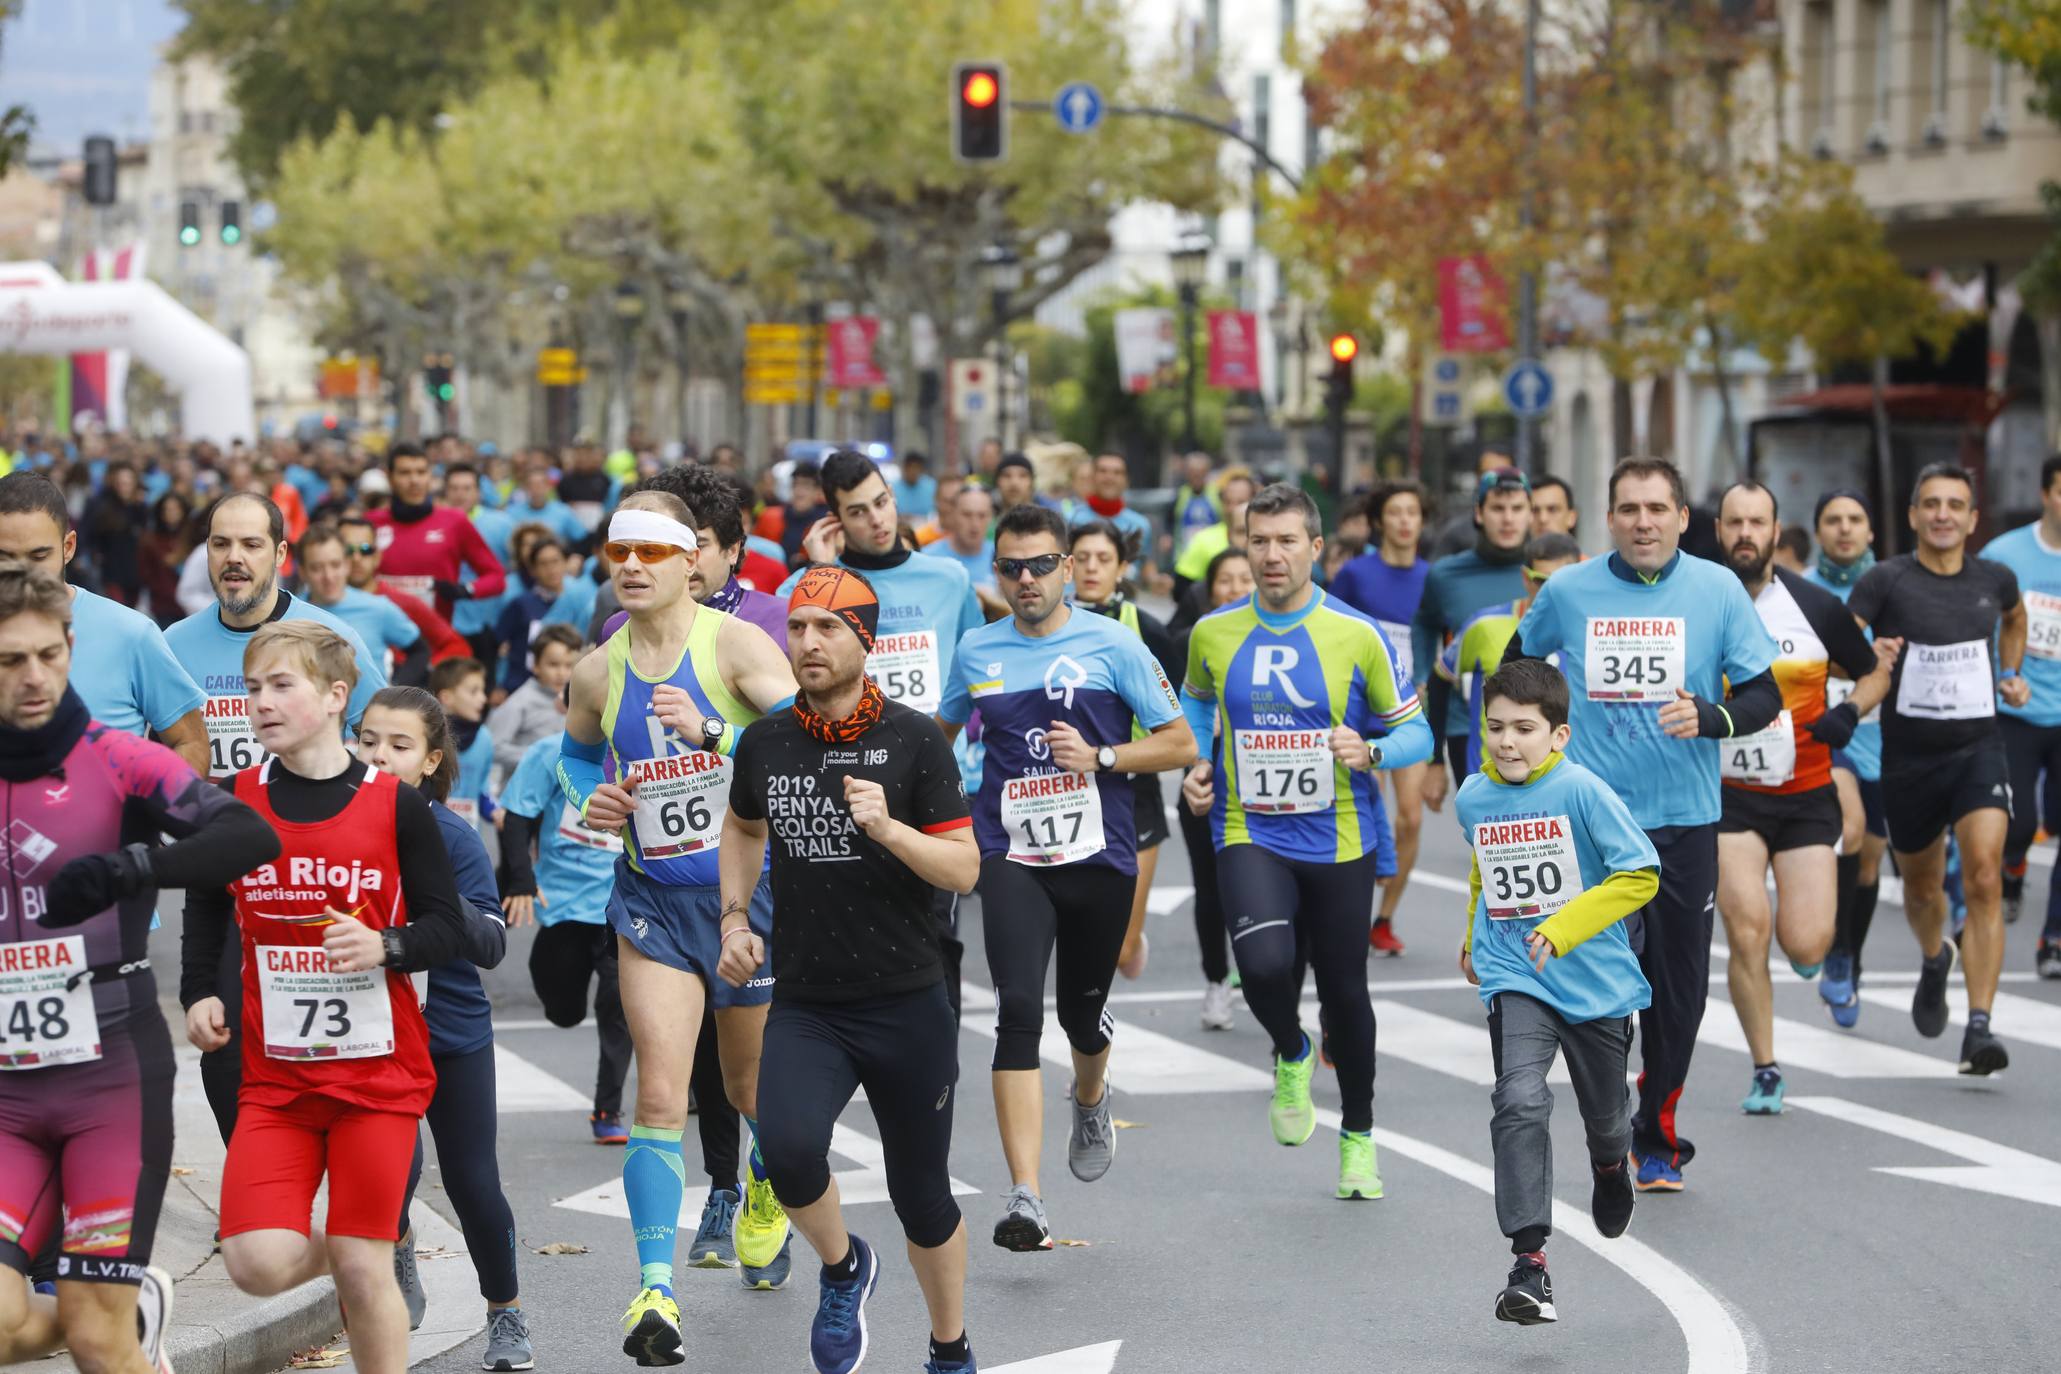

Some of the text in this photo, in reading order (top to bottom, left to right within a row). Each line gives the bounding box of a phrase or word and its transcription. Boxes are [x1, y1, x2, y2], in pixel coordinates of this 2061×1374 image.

[1594, 621, 1676, 637] CARRERA
[1920, 646, 1979, 662] CARRERA
[1252, 645, 1317, 709] R
[1603, 656, 1667, 685] 345
[1253, 714, 1296, 726] RIOJA
[1243, 733, 1325, 750] CARRERA
[635, 752, 723, 783] CARRERA
[1732, 748, 1770, 771] 41
[767, 776, 816, 796] 2019
[1009, 769, 1088, 800] CARRERA
[1254, 768, 1318, 797] 176
[660, 796, 711, 837] 66
[768, 797, 845, 817] PENYA-
[773, 816, 859, 838] GOLOSA
[1020, 811, 1083, 848] 117
[1479, 820, 1563, 846] CARRERA
[784, 836, 851, 858] TRAILS
[290, 857, 382, 903] Rioja
[1493, 862, 1562, 901] 350
[245, 888, 327, 902] atletismo
[0, 942, 73, 973] RERA
[267, 950, 376, 973] CARR
[0, 997, 70, 1043] 48
[294, 998, 351, 1038] 73
